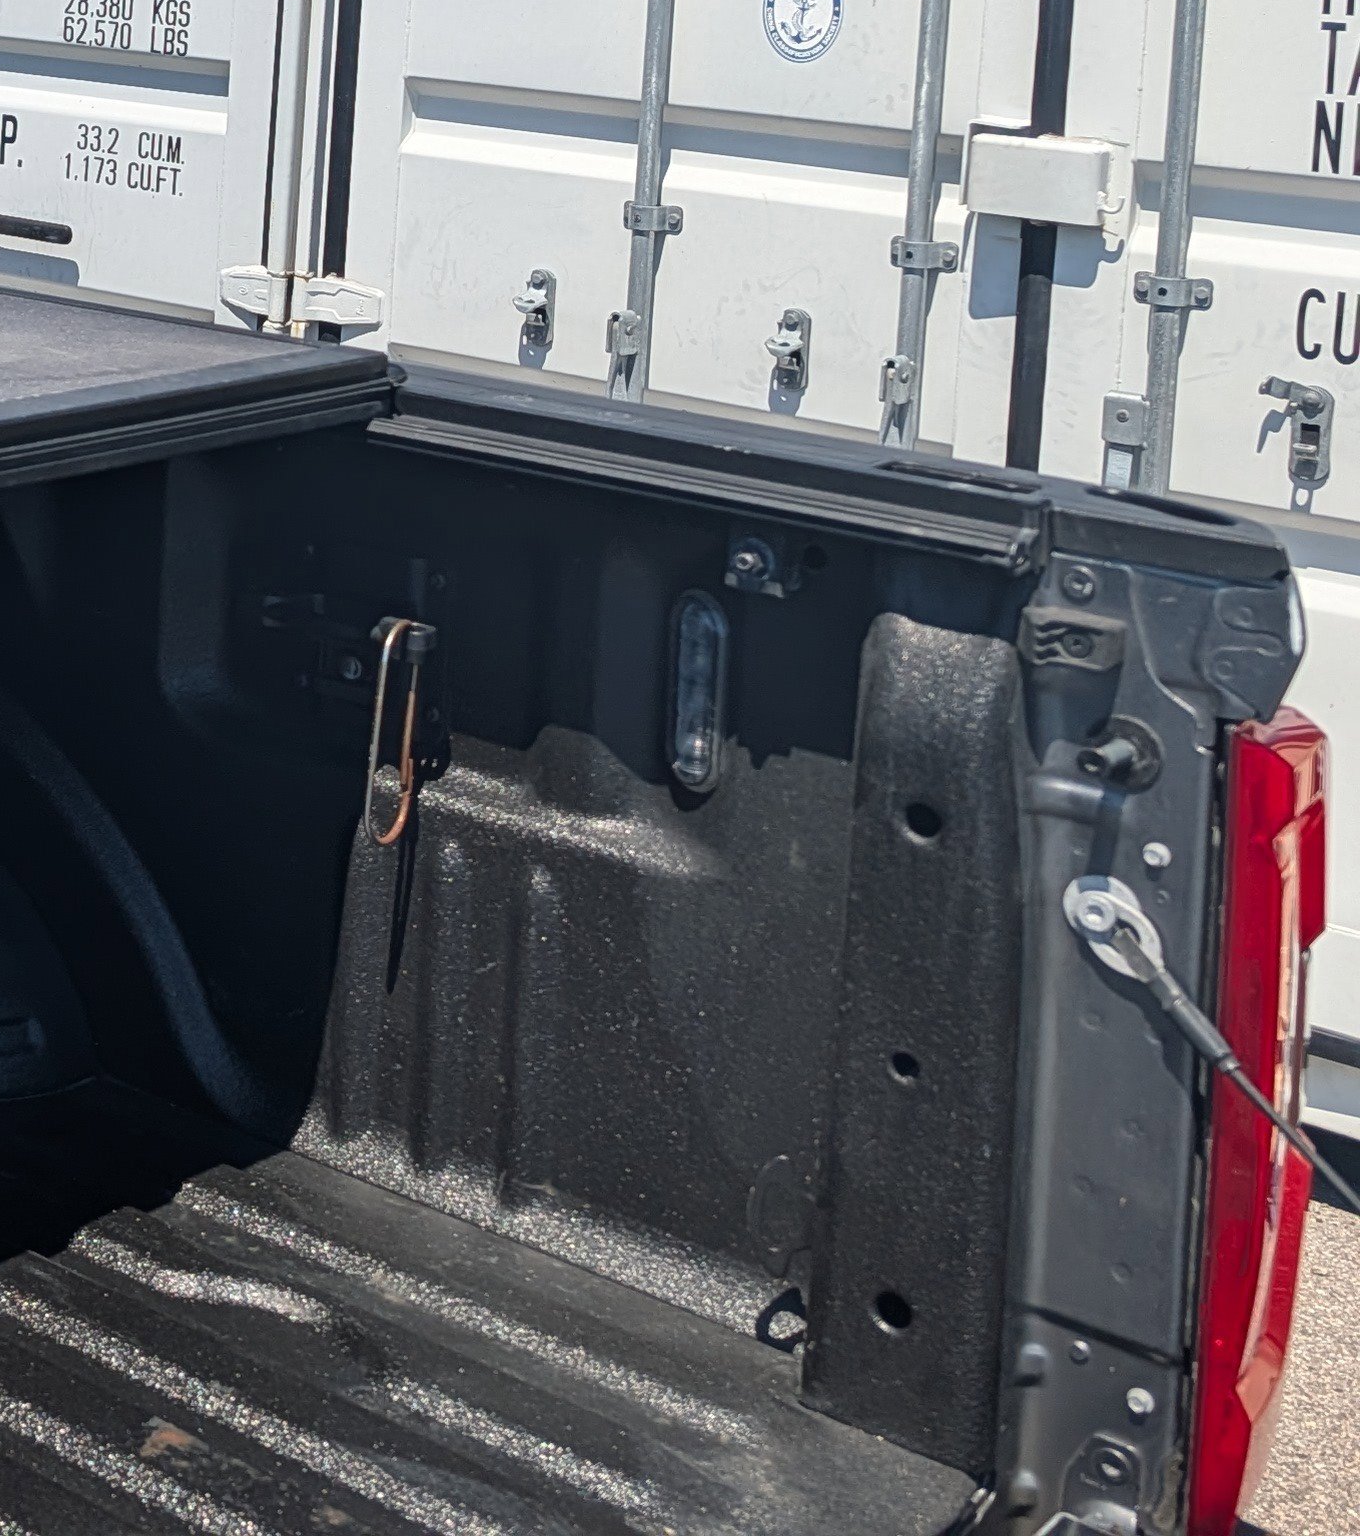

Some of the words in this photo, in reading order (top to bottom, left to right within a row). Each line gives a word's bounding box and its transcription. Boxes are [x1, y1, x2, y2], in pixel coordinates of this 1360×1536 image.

[62, 16, 132, 50] 62,570
[149, 26, 189, 57] LBS
[76, 123, 121, 155] 33.2
[137, 131, 186, 165] CU.M.
[63, 152, 118, 186] 1,173
[126, 161, 184, 197] CU.FT.
